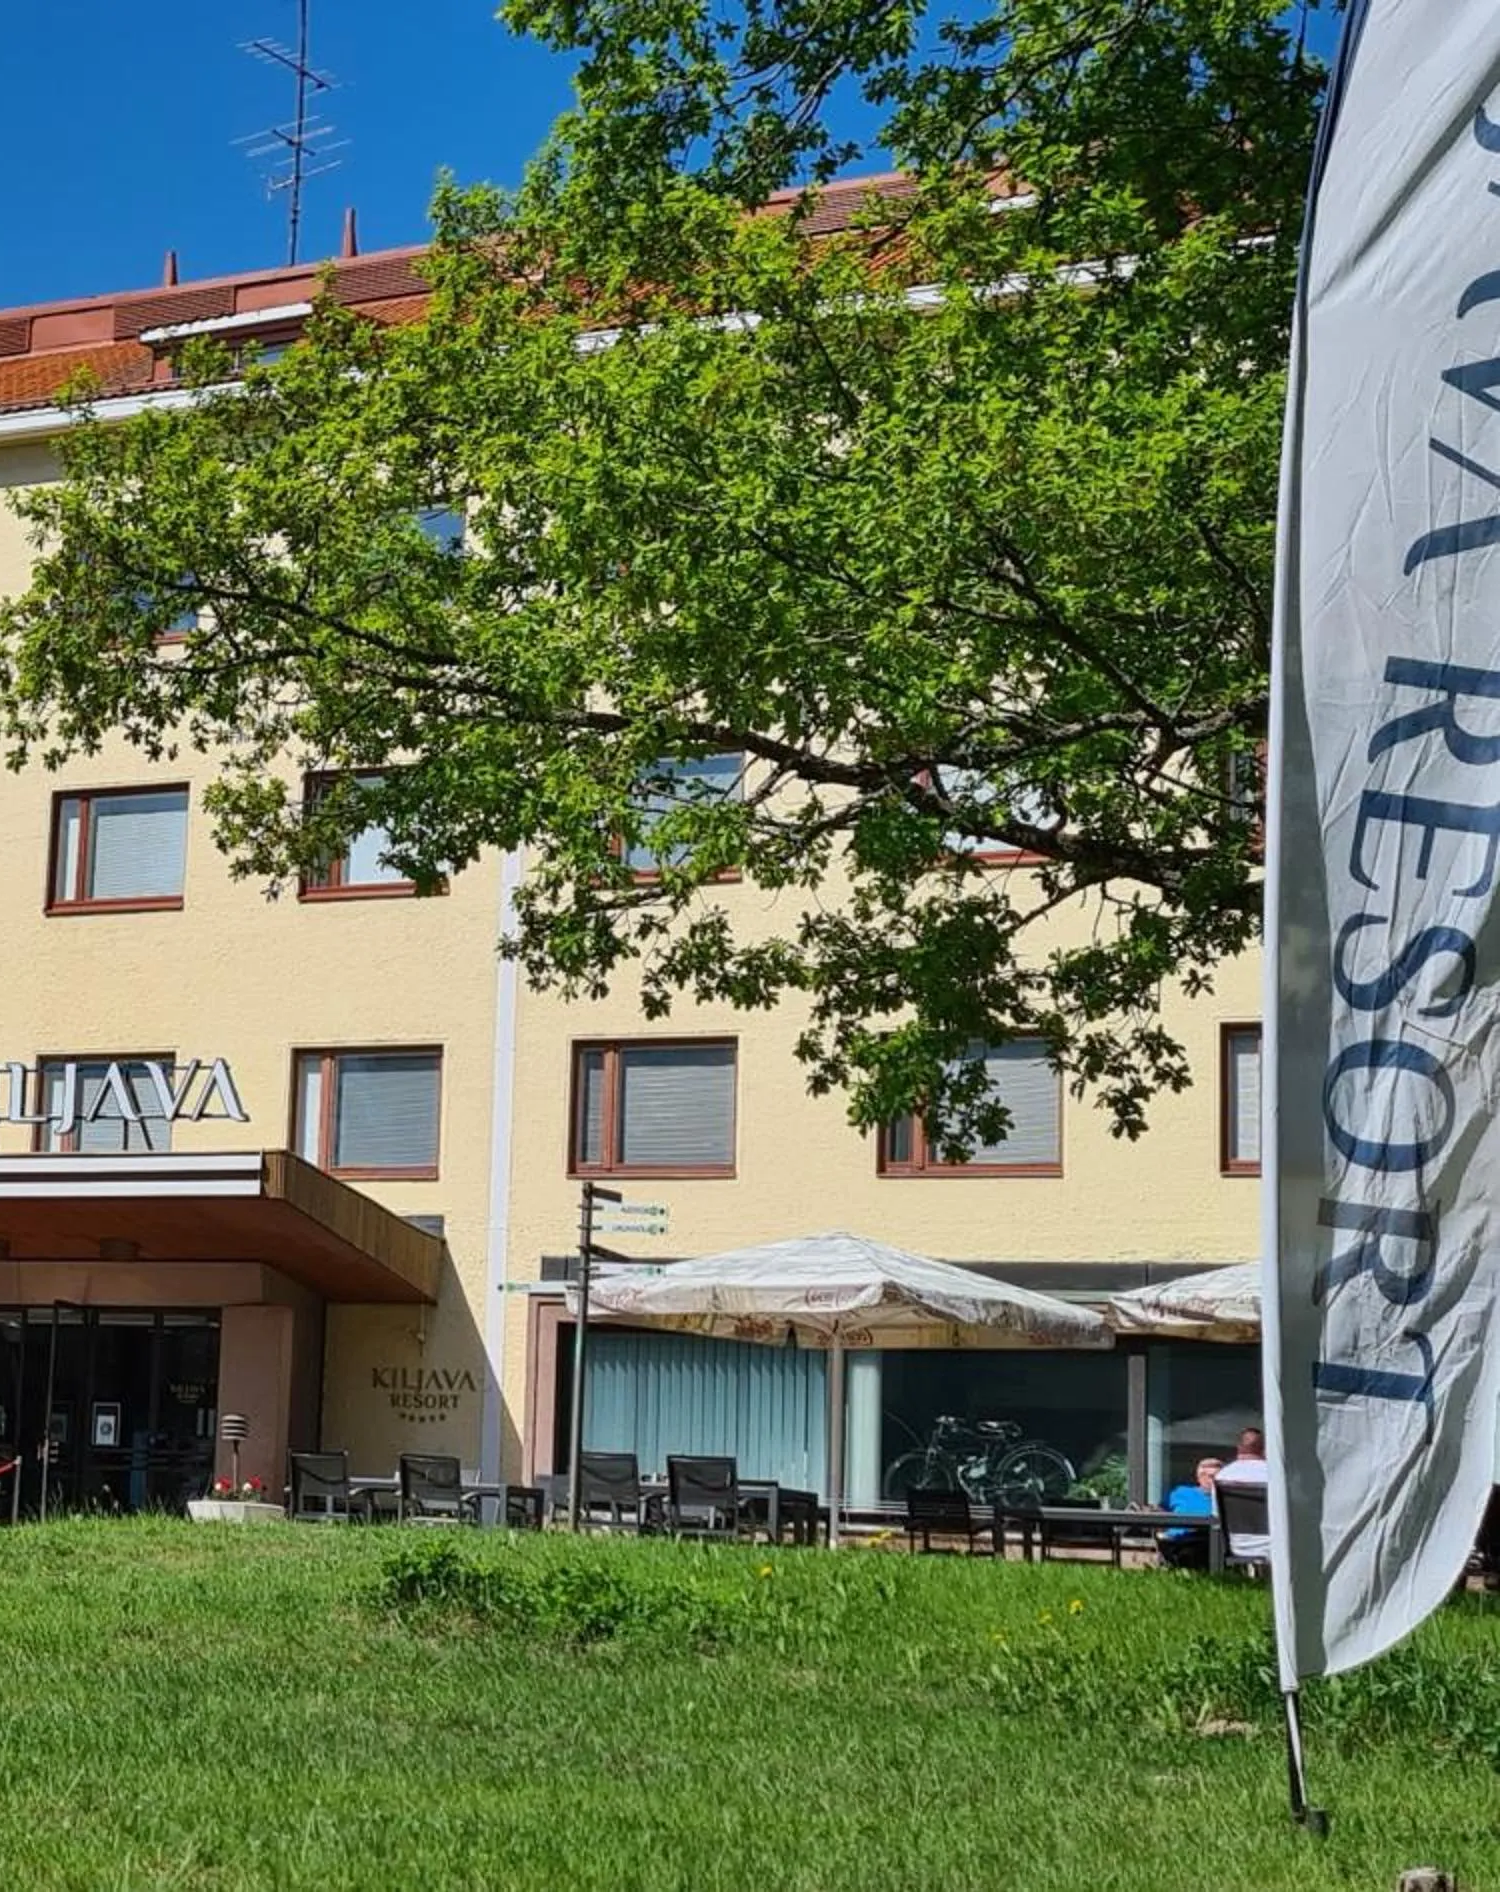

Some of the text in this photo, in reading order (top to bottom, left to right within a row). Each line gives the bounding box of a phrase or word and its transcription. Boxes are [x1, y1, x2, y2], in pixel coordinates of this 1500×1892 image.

[1311, 655, 1500, 1444] RESORT
[372, 1367, 477, 1394] KILJAVA
[389, 1393, 459, 1410] RESORT
